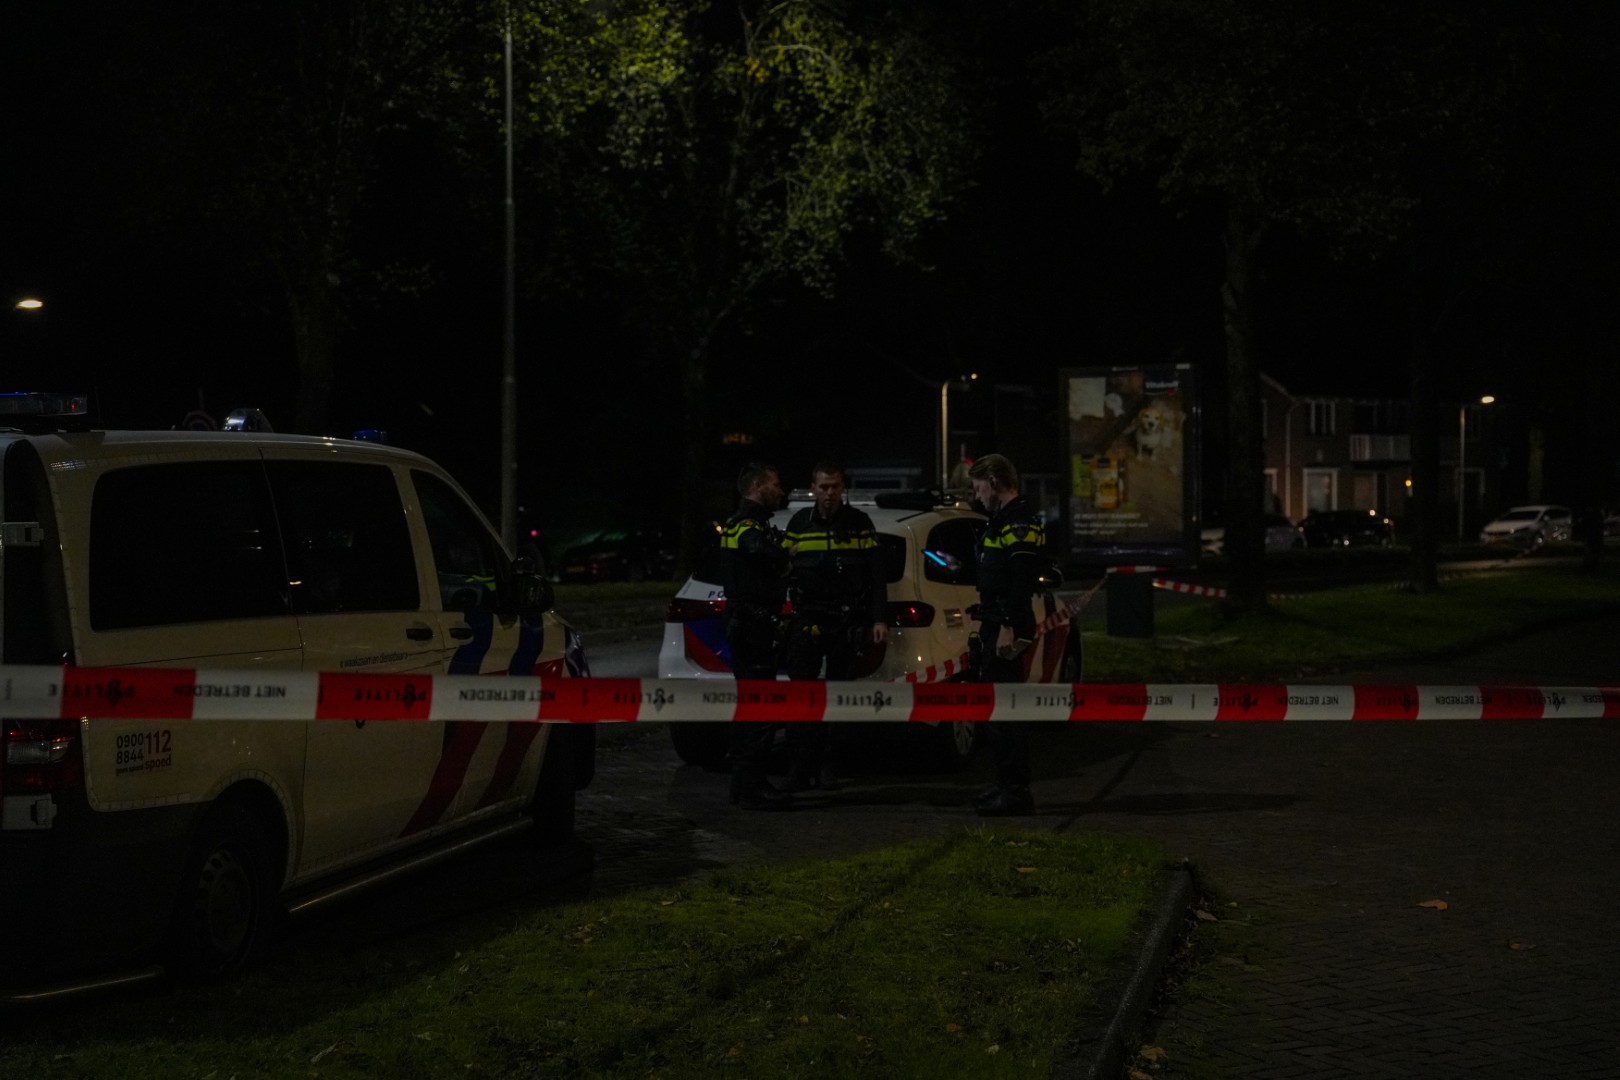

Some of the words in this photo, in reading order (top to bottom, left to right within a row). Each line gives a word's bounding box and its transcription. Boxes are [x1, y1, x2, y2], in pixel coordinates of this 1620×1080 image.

[172, 684, 251, 698] BETREDEN
[254, 685, 286, 698] NIET
[459, 689, 526, 702] BETREDEN
[528, 689, 557, 703] NIET
[702, 692, 760, 704] BETREDEN
[763, 692, 787, 704] NIET
[917, 695, 969, 705] BETREDEN
[970, 695, 992, 705] NIET
[1106, 695, 1152, 706] BETREDEN
[1153, 695, 1172, 706] NIET
[1277, 695, 1320, 705] BETREDEN
[1321, 695, 1338, 705] NIET
[1435, 695, 1475, 705] BETREDEN
[1476, 695, 1493, 705] NIET
[116, 733, 144, 749] 0900
[145, 729, 172, 754] 112
[116, 749, 144, 764] 8844
[145, 754, 171, 772] spoed
